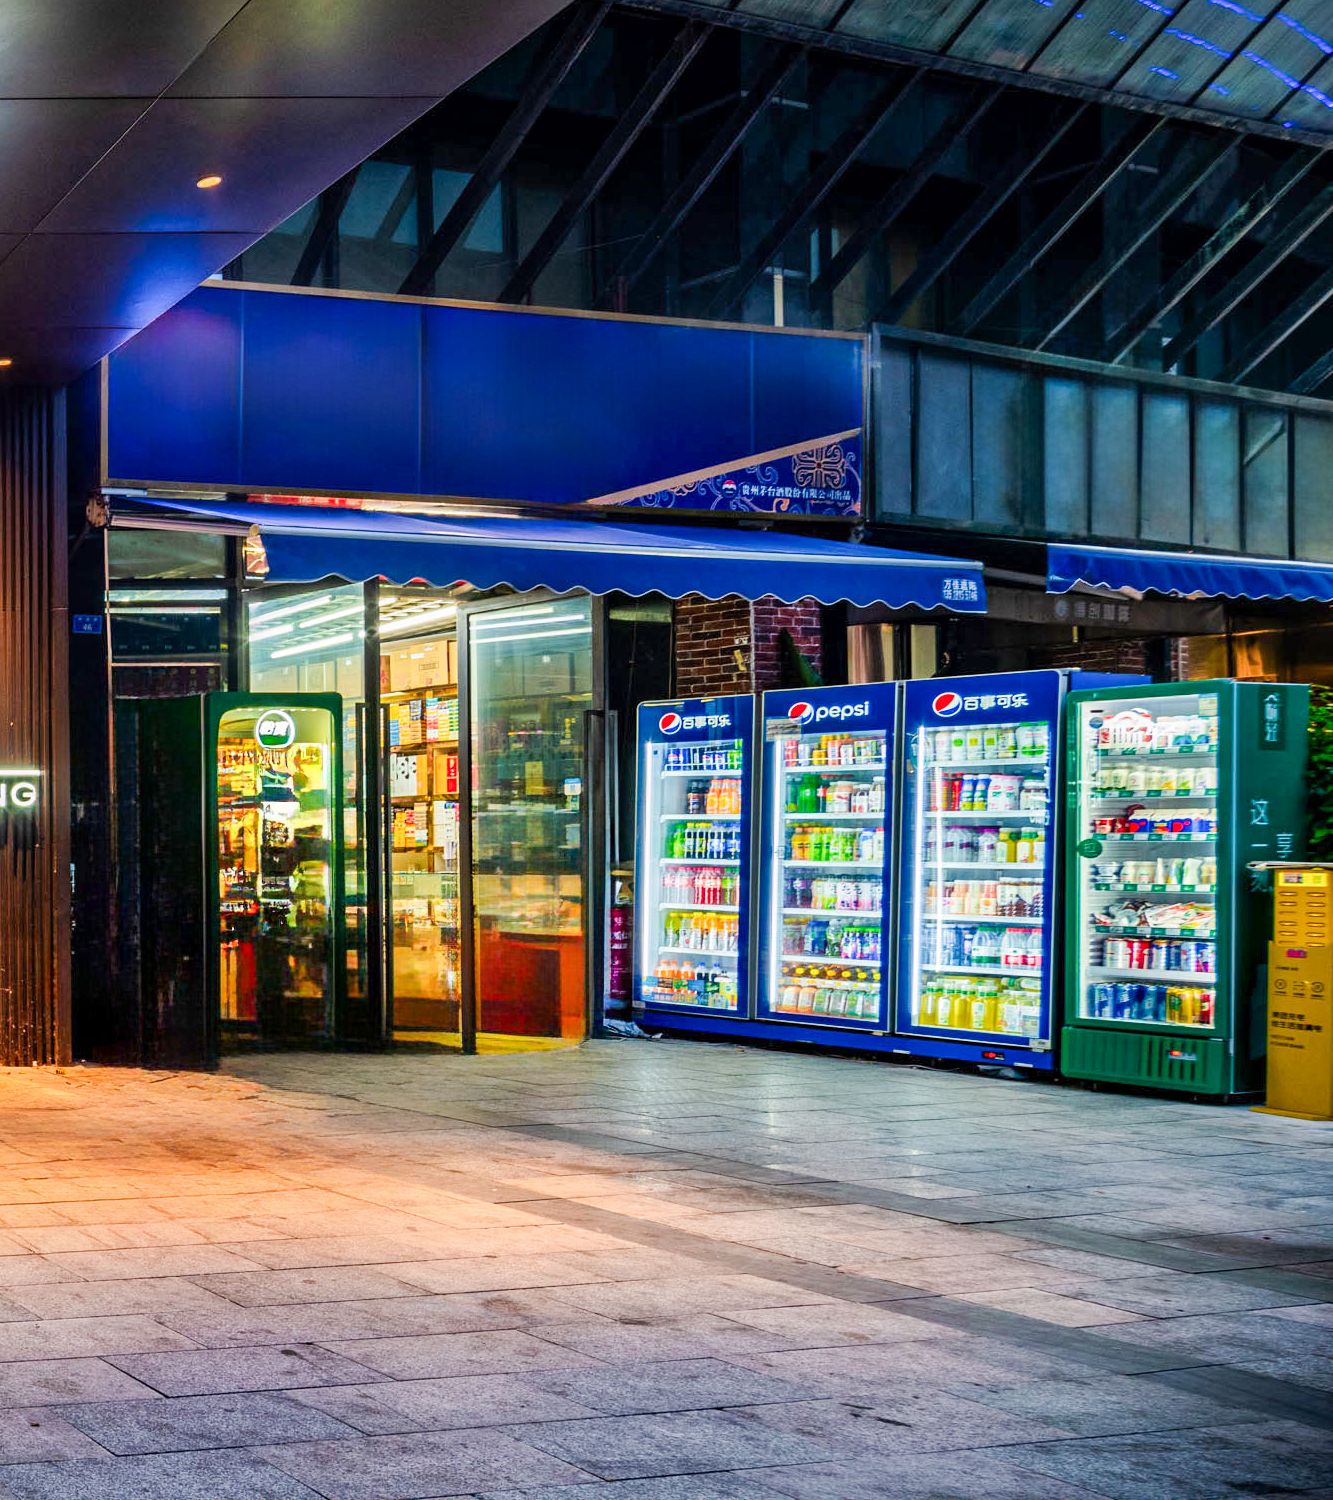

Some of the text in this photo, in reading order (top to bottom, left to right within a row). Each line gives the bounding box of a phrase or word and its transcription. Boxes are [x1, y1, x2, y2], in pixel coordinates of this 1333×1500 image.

[963, 693, 1029, 711] 百事可乐
[815, 701, 870, 722] pepsi
[682, 713, 731, 729] 百事可乐
